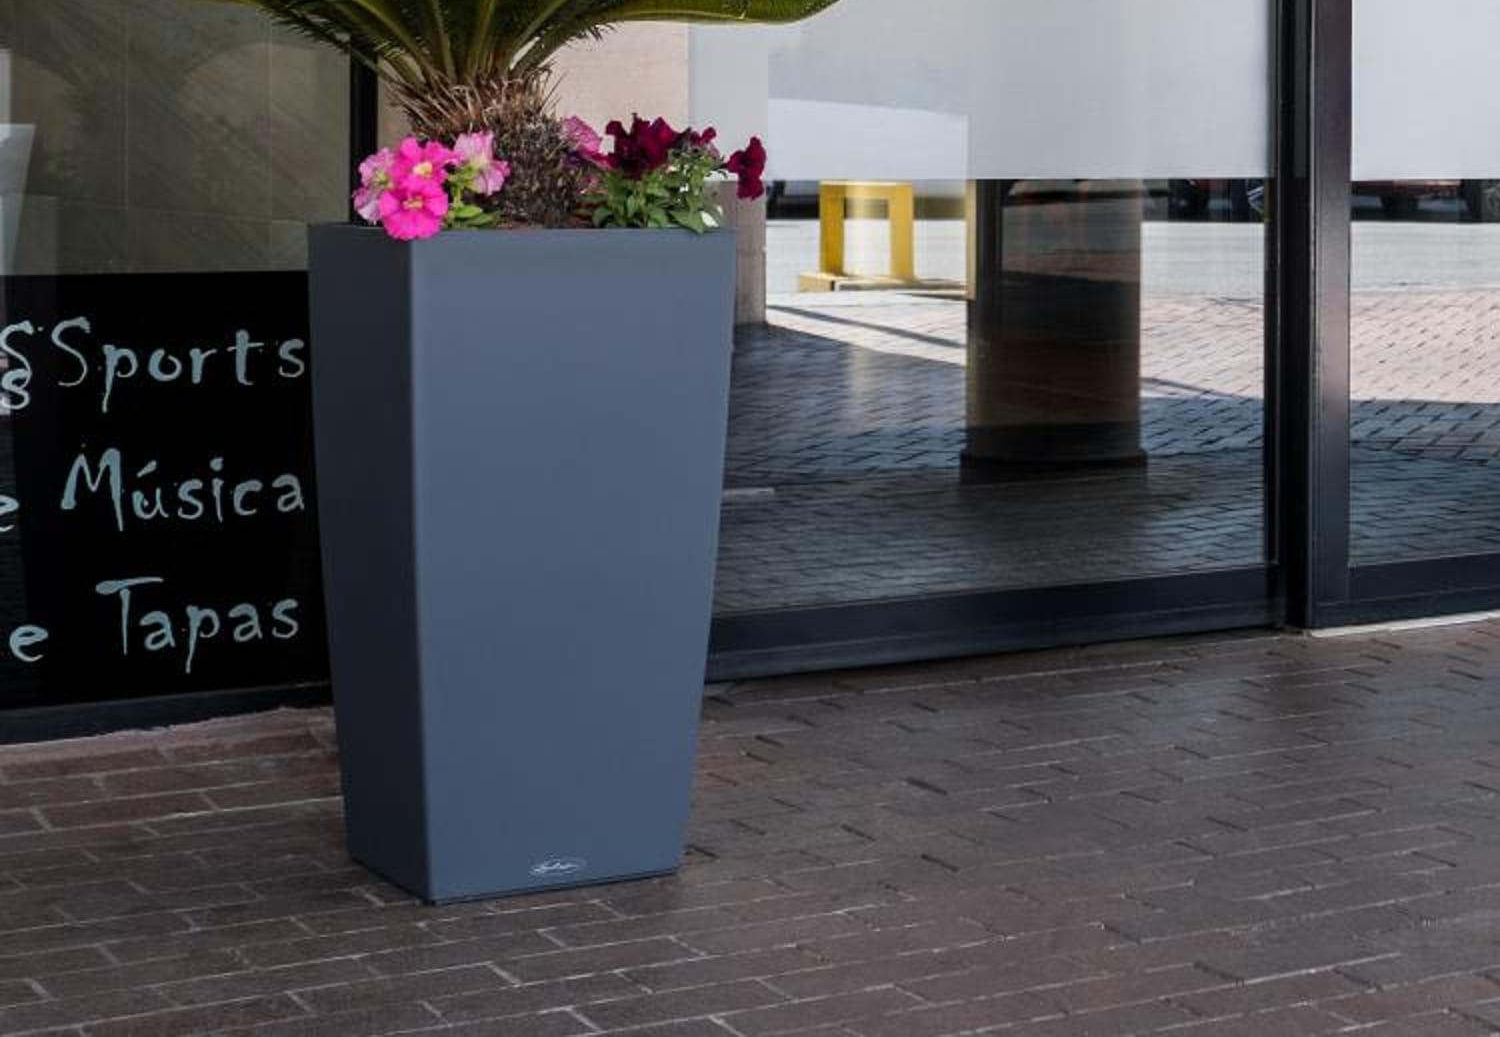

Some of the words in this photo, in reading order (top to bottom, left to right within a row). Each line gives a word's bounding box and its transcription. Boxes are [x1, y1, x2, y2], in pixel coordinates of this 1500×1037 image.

[51, 316, 305, 413] Sports
[61, 448, 305, 531] Música
[95, 576, 299, 674] Tapas
